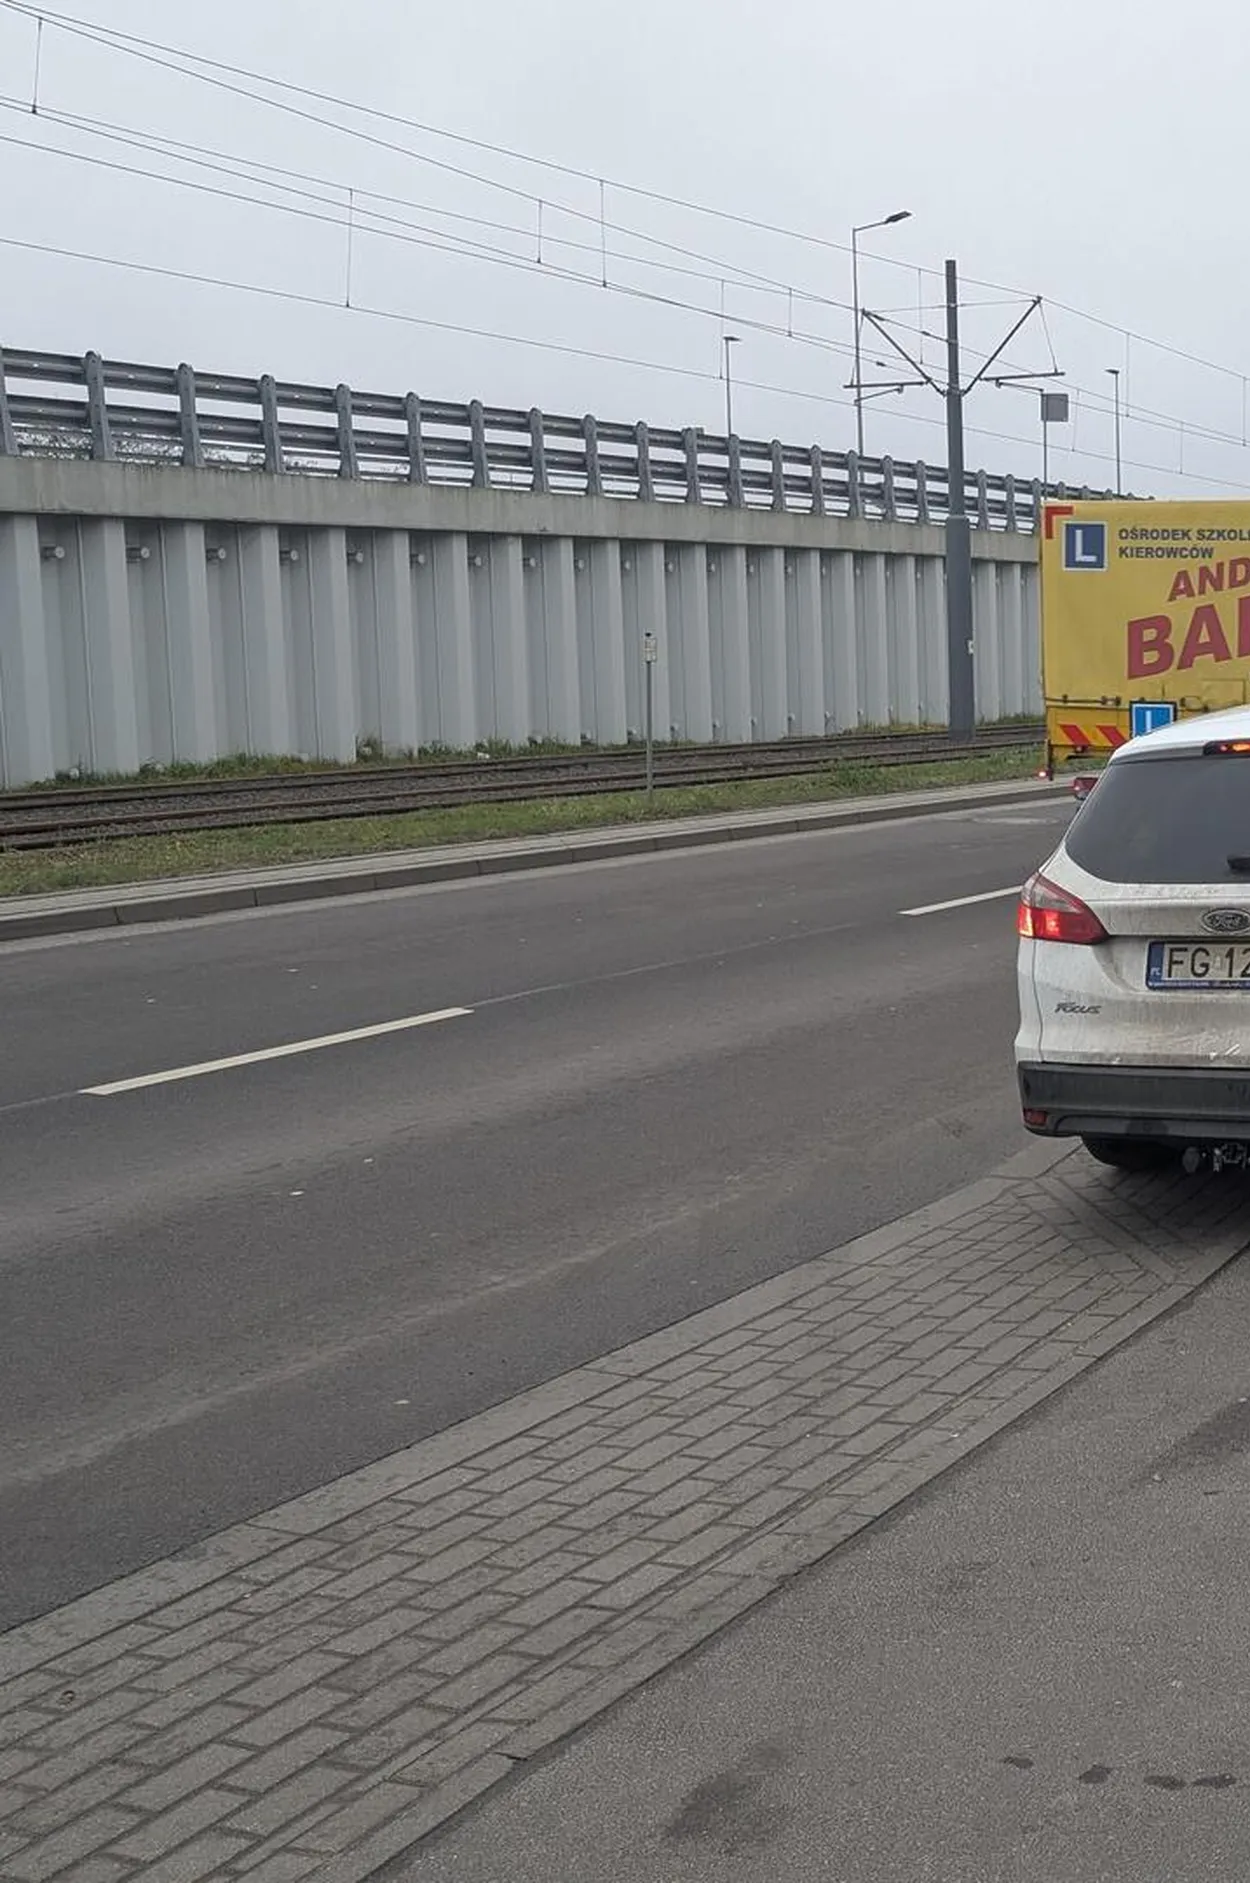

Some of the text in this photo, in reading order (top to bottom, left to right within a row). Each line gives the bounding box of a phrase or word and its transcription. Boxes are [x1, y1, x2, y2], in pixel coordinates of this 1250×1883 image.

[1118, 527, 1192, 541] OŚRODEK
[1075, 529, 1097, 562] L
[1118, 545, 1214, 559] KIEROWCÓW
[1168, 947, 1210, 978] FG
